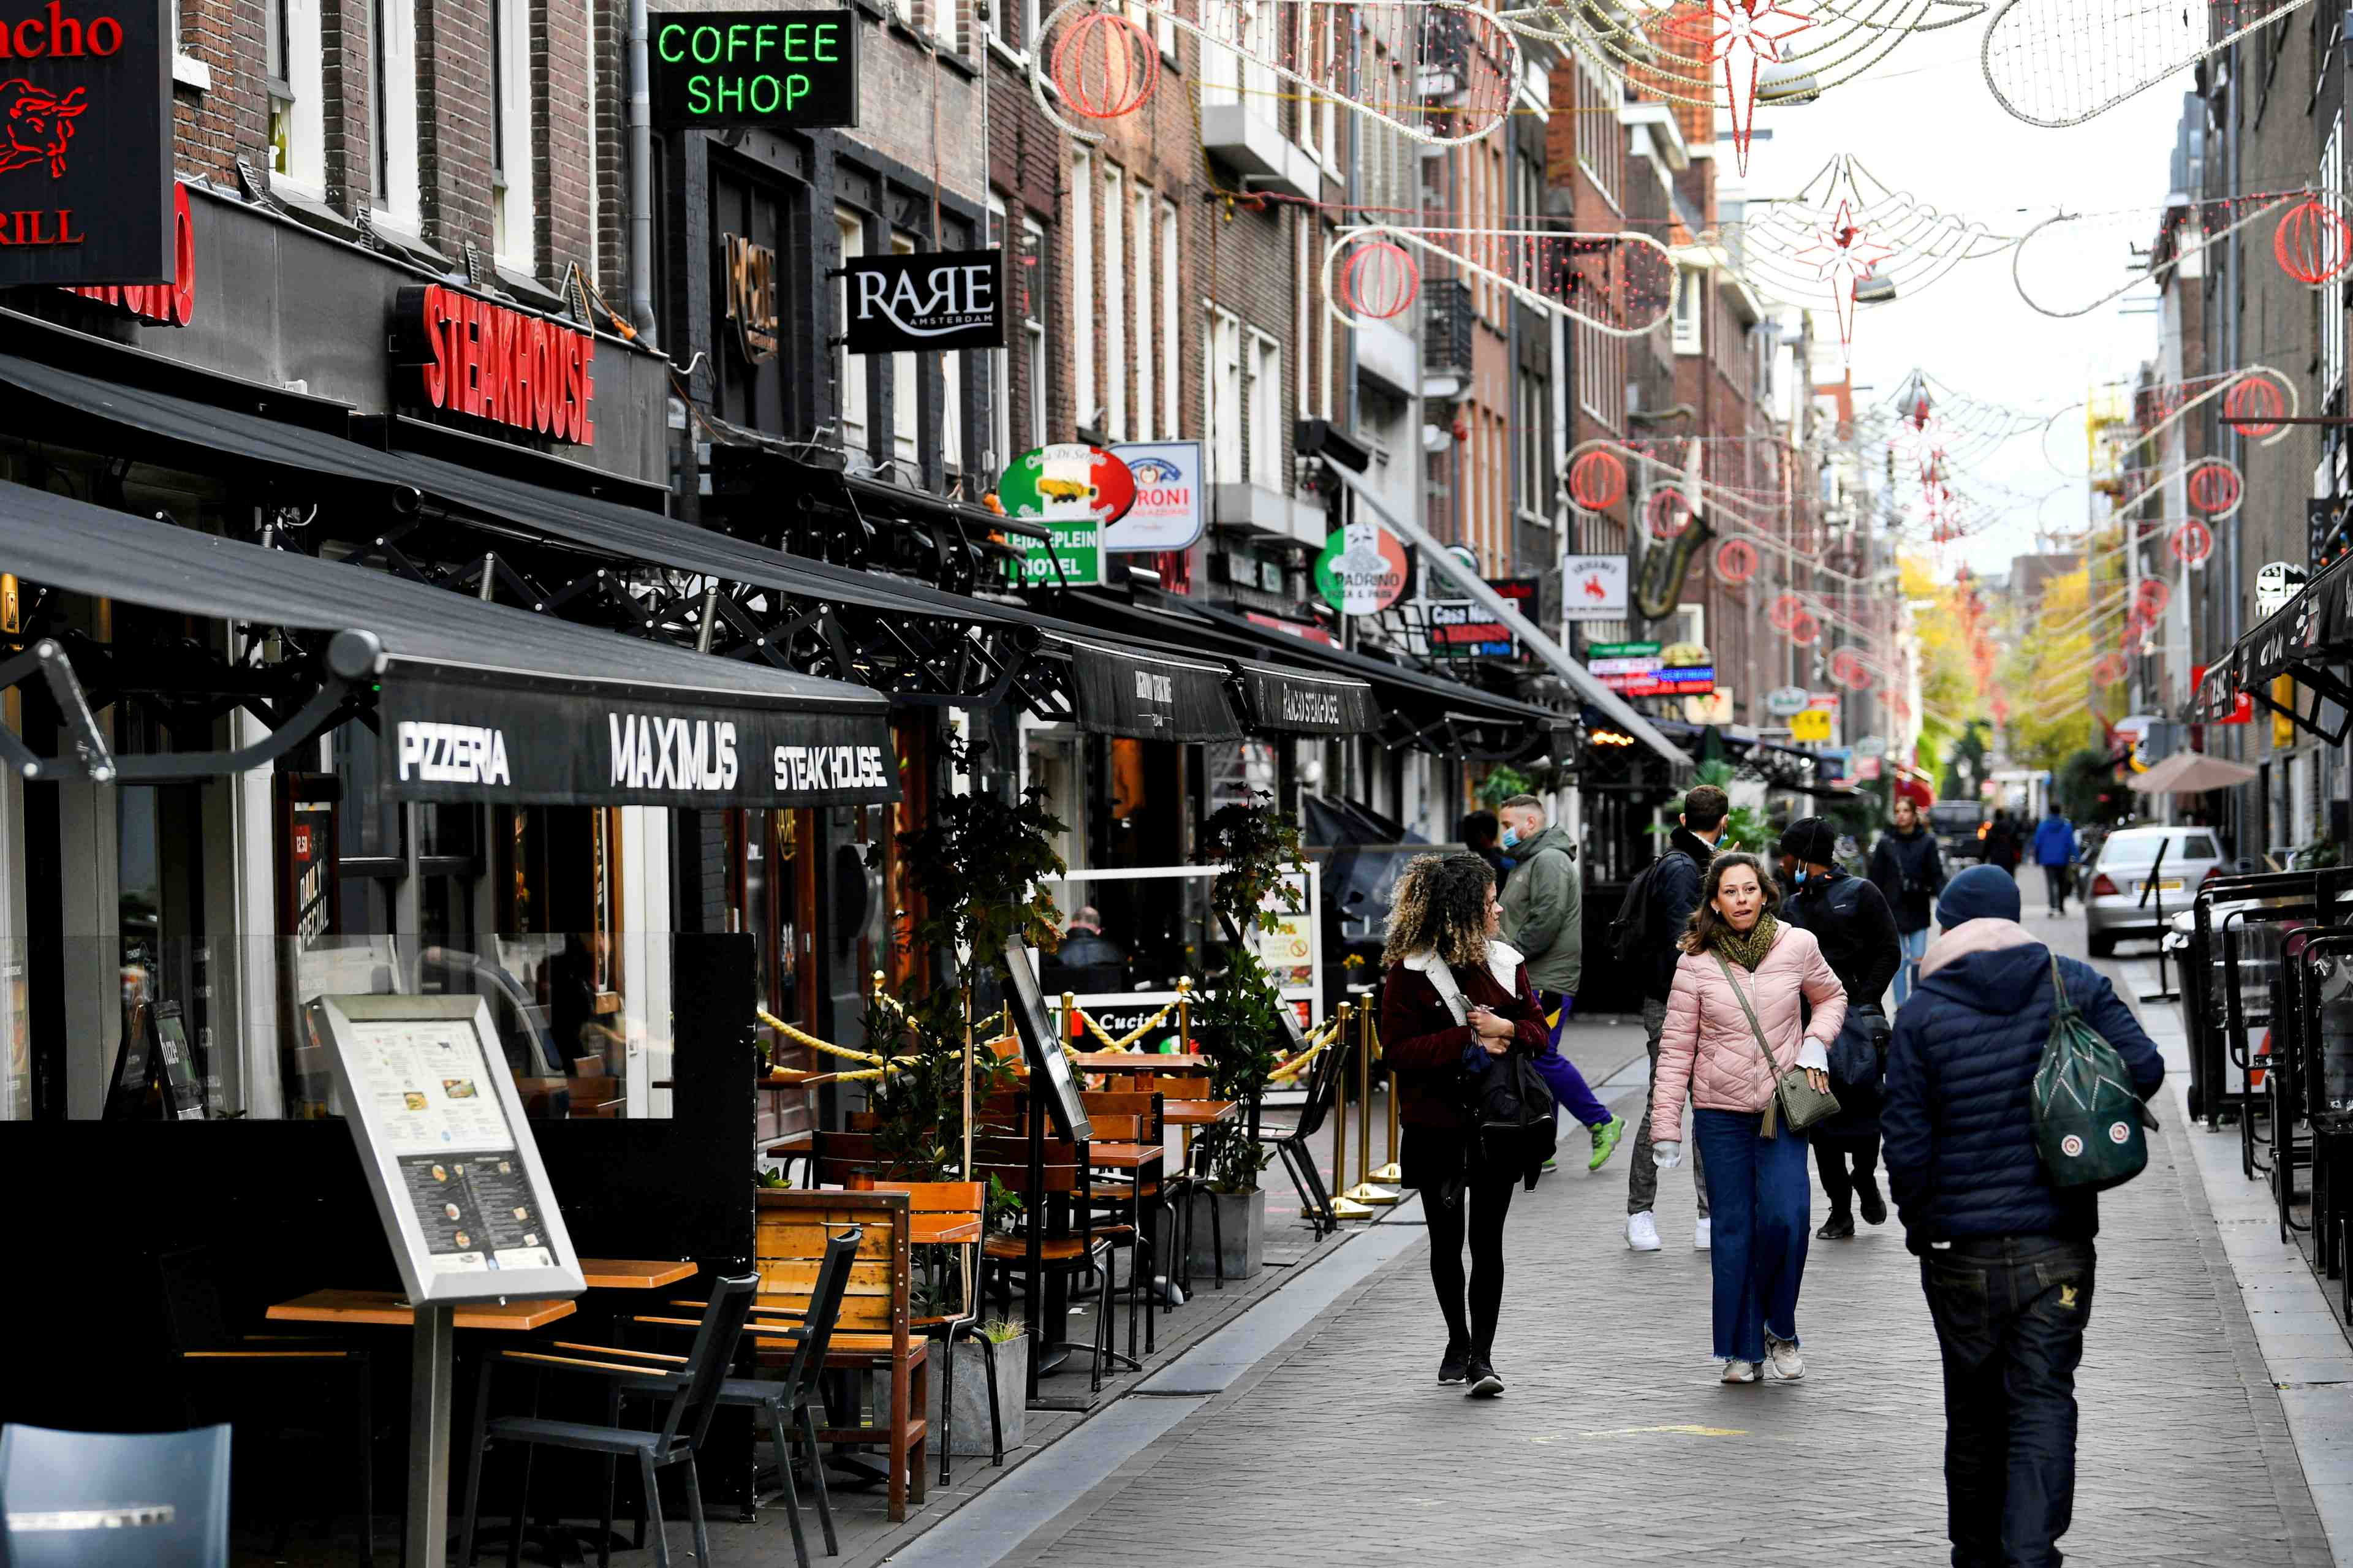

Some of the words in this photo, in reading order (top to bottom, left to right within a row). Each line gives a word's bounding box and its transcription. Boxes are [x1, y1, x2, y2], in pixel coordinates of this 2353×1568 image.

[658, 24, 839, 63] COFFEE
[687, 74, 810, 115] SHOP
[909, 314, 993, 326] AMSTERDAM
[423, 283, 594, 446] STEAKHOUSE
[1021, 558, 1082, 576] HOTEL
[398, 721, 511, 786] PIZZERIA
[608, 712, 738, 790] MAXIMUS
[774, 745, 828, 790] STEAK
[828, 745, 888, 789] HOUSE
[300, 858, 324, 912] DAILY
[297, 895, 330, 958] SPECIAL
[1099, 1012, 1167, 1030] Cucia
